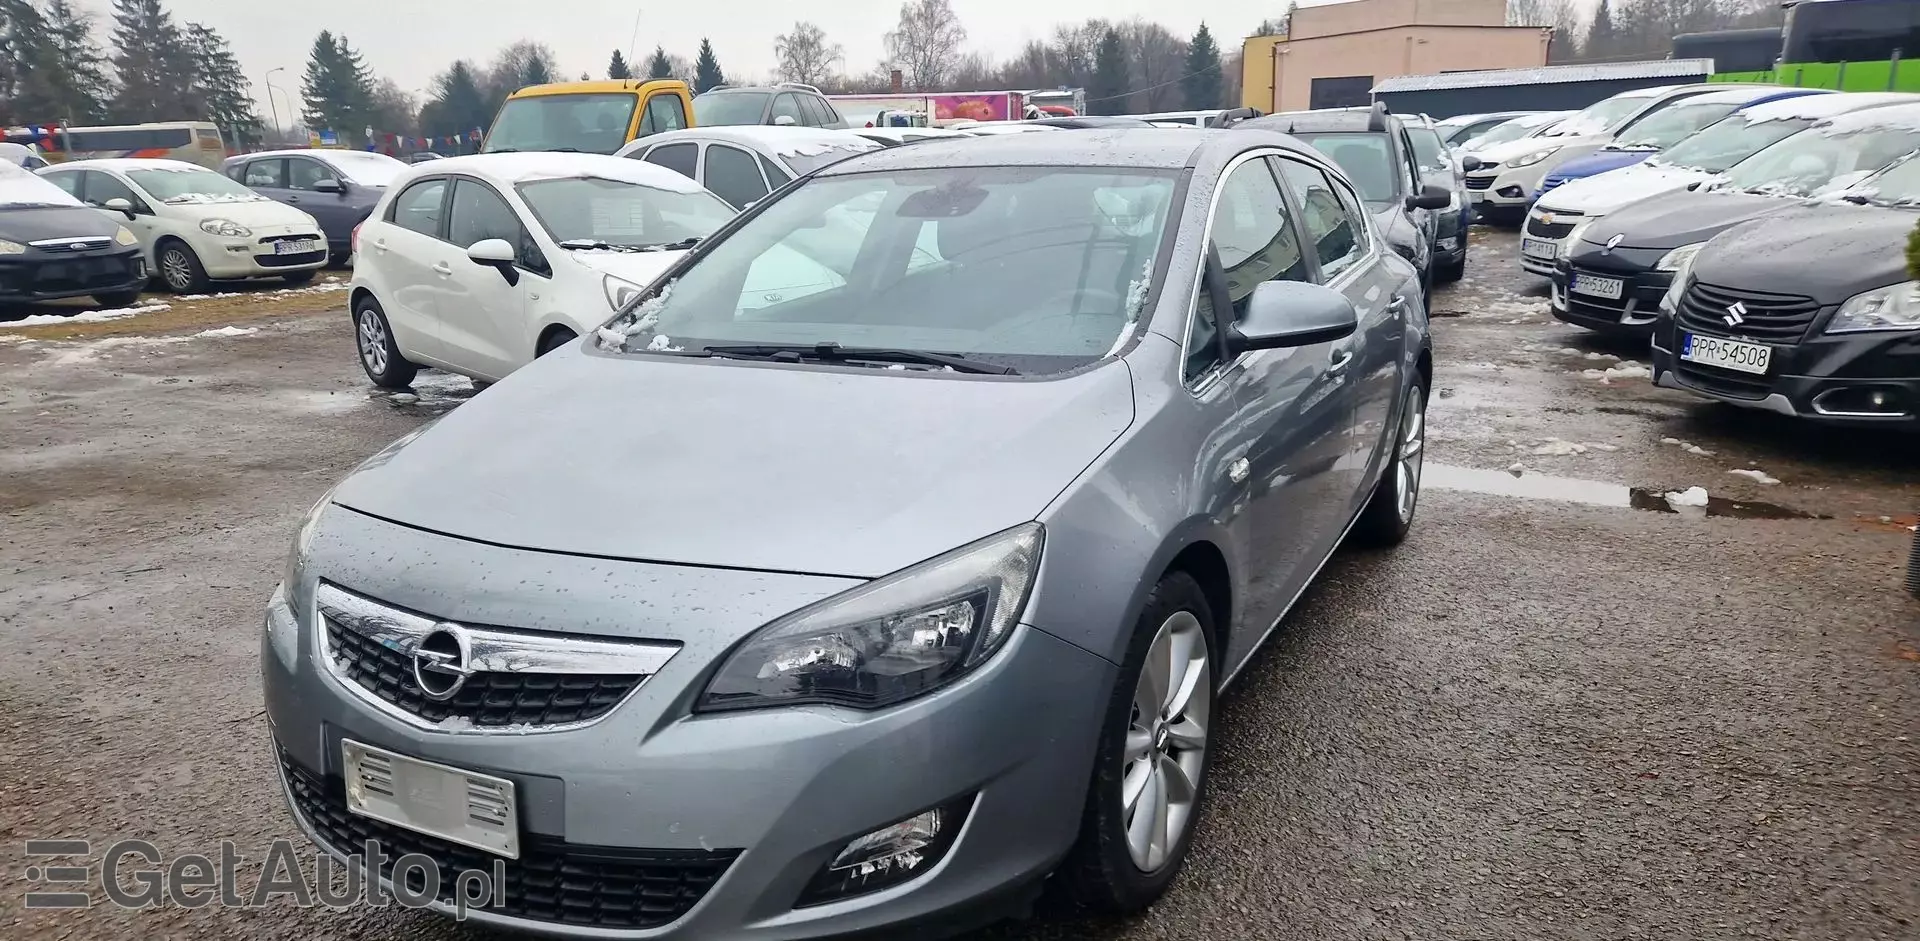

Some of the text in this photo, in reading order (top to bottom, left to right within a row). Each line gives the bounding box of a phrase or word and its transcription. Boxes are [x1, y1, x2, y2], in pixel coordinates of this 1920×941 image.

[1592, 278, 1620, 295] 53261
[1692, 337, 1767, 367] RPR 54508
